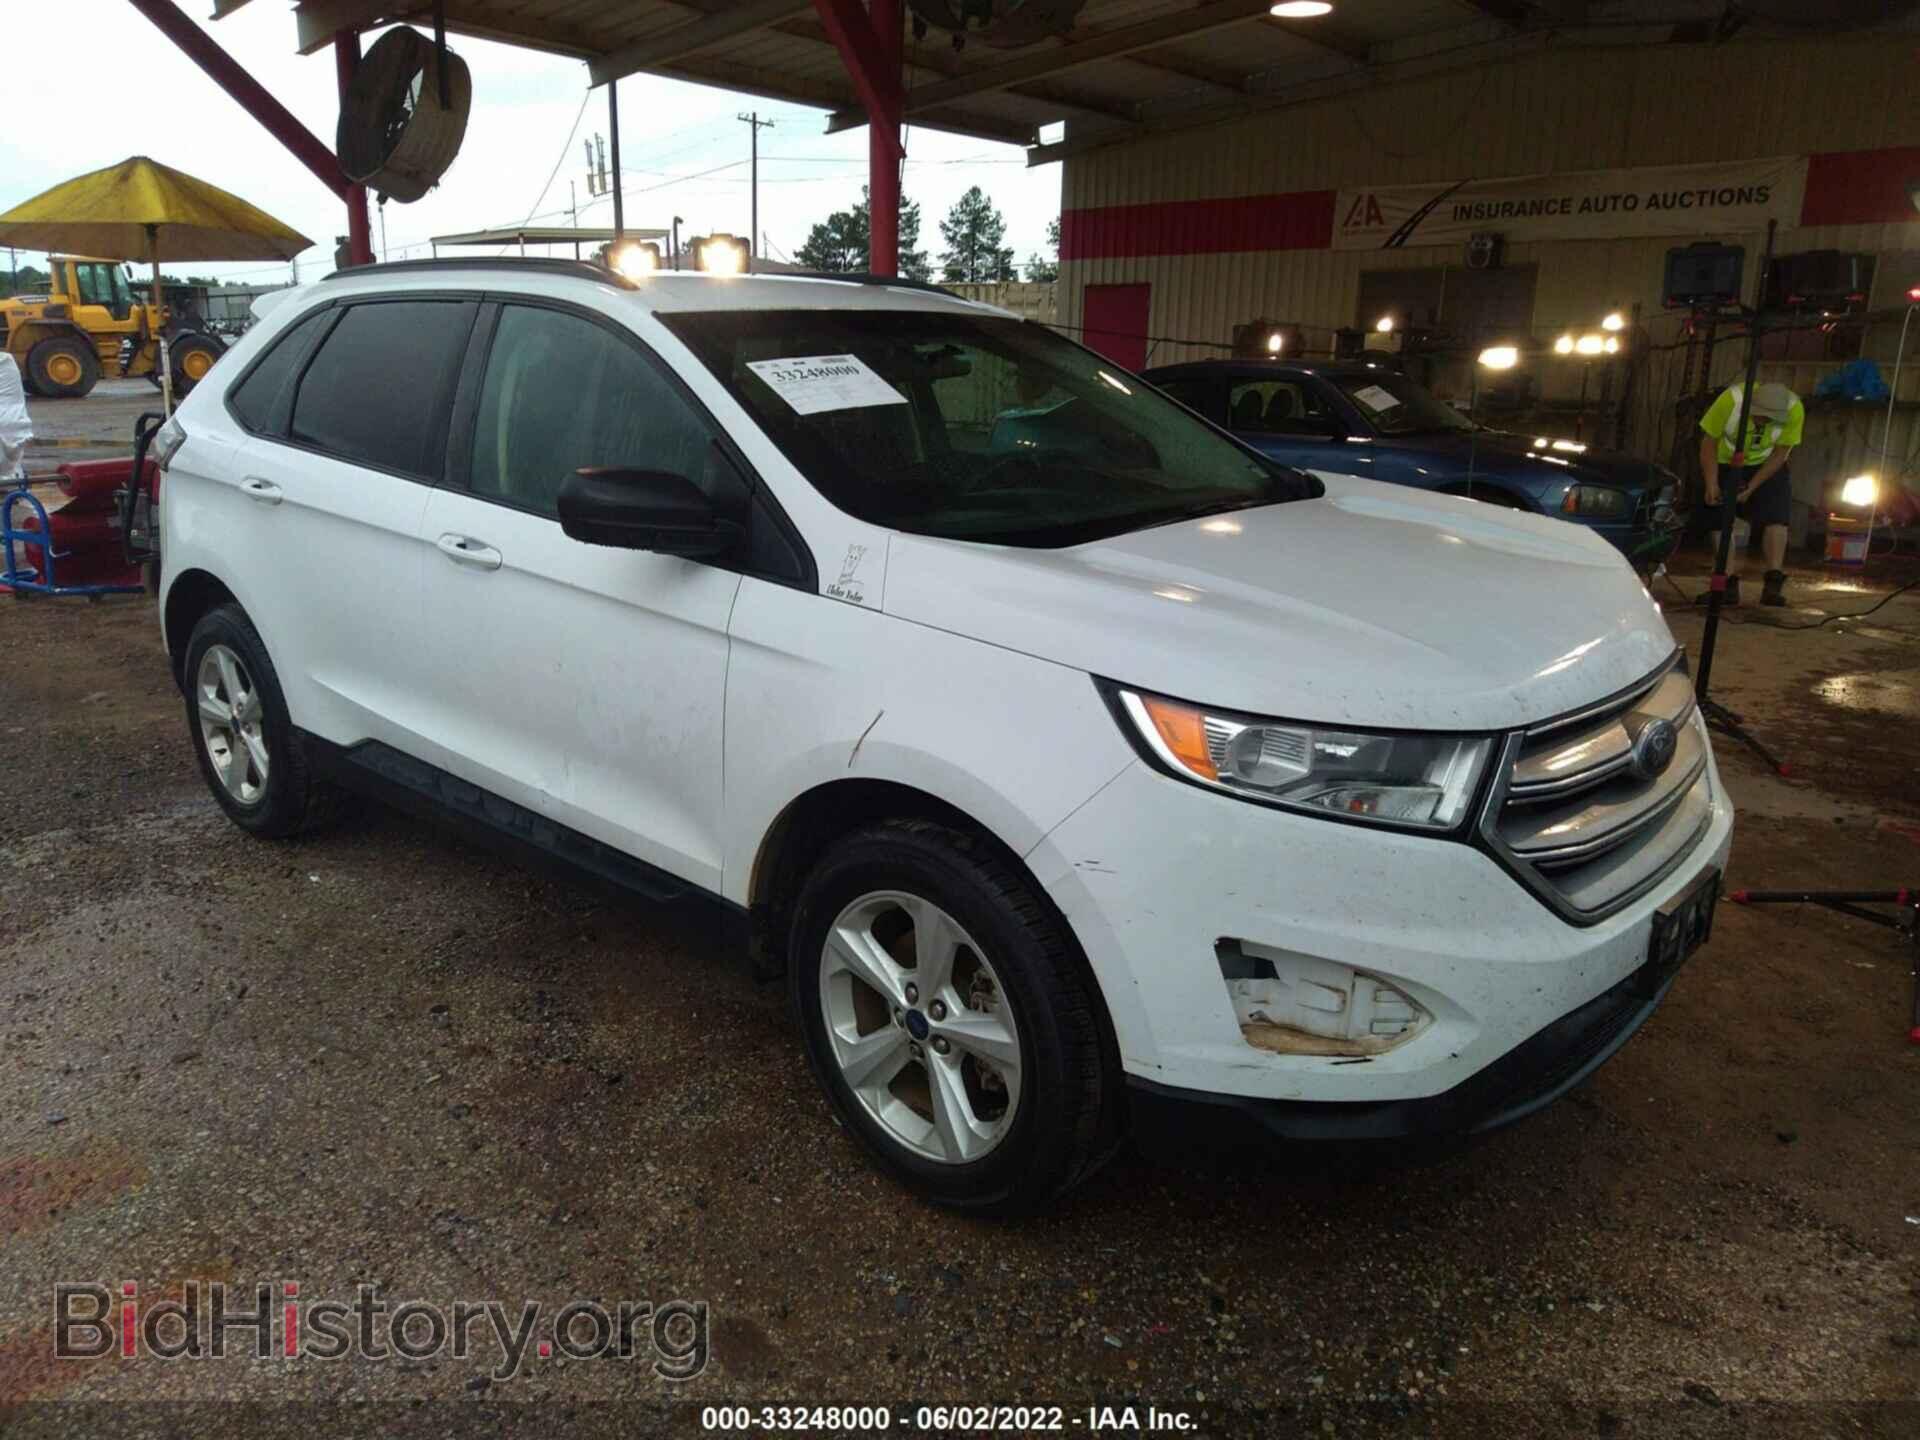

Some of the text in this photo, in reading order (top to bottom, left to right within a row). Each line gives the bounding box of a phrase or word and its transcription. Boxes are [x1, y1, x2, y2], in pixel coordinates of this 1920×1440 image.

[1453, 198, 1572, 222] INSURANCE
[1579, 194, 1639, 213] AUTO
[1645, 186, 1770, 210] AUCTIONS
